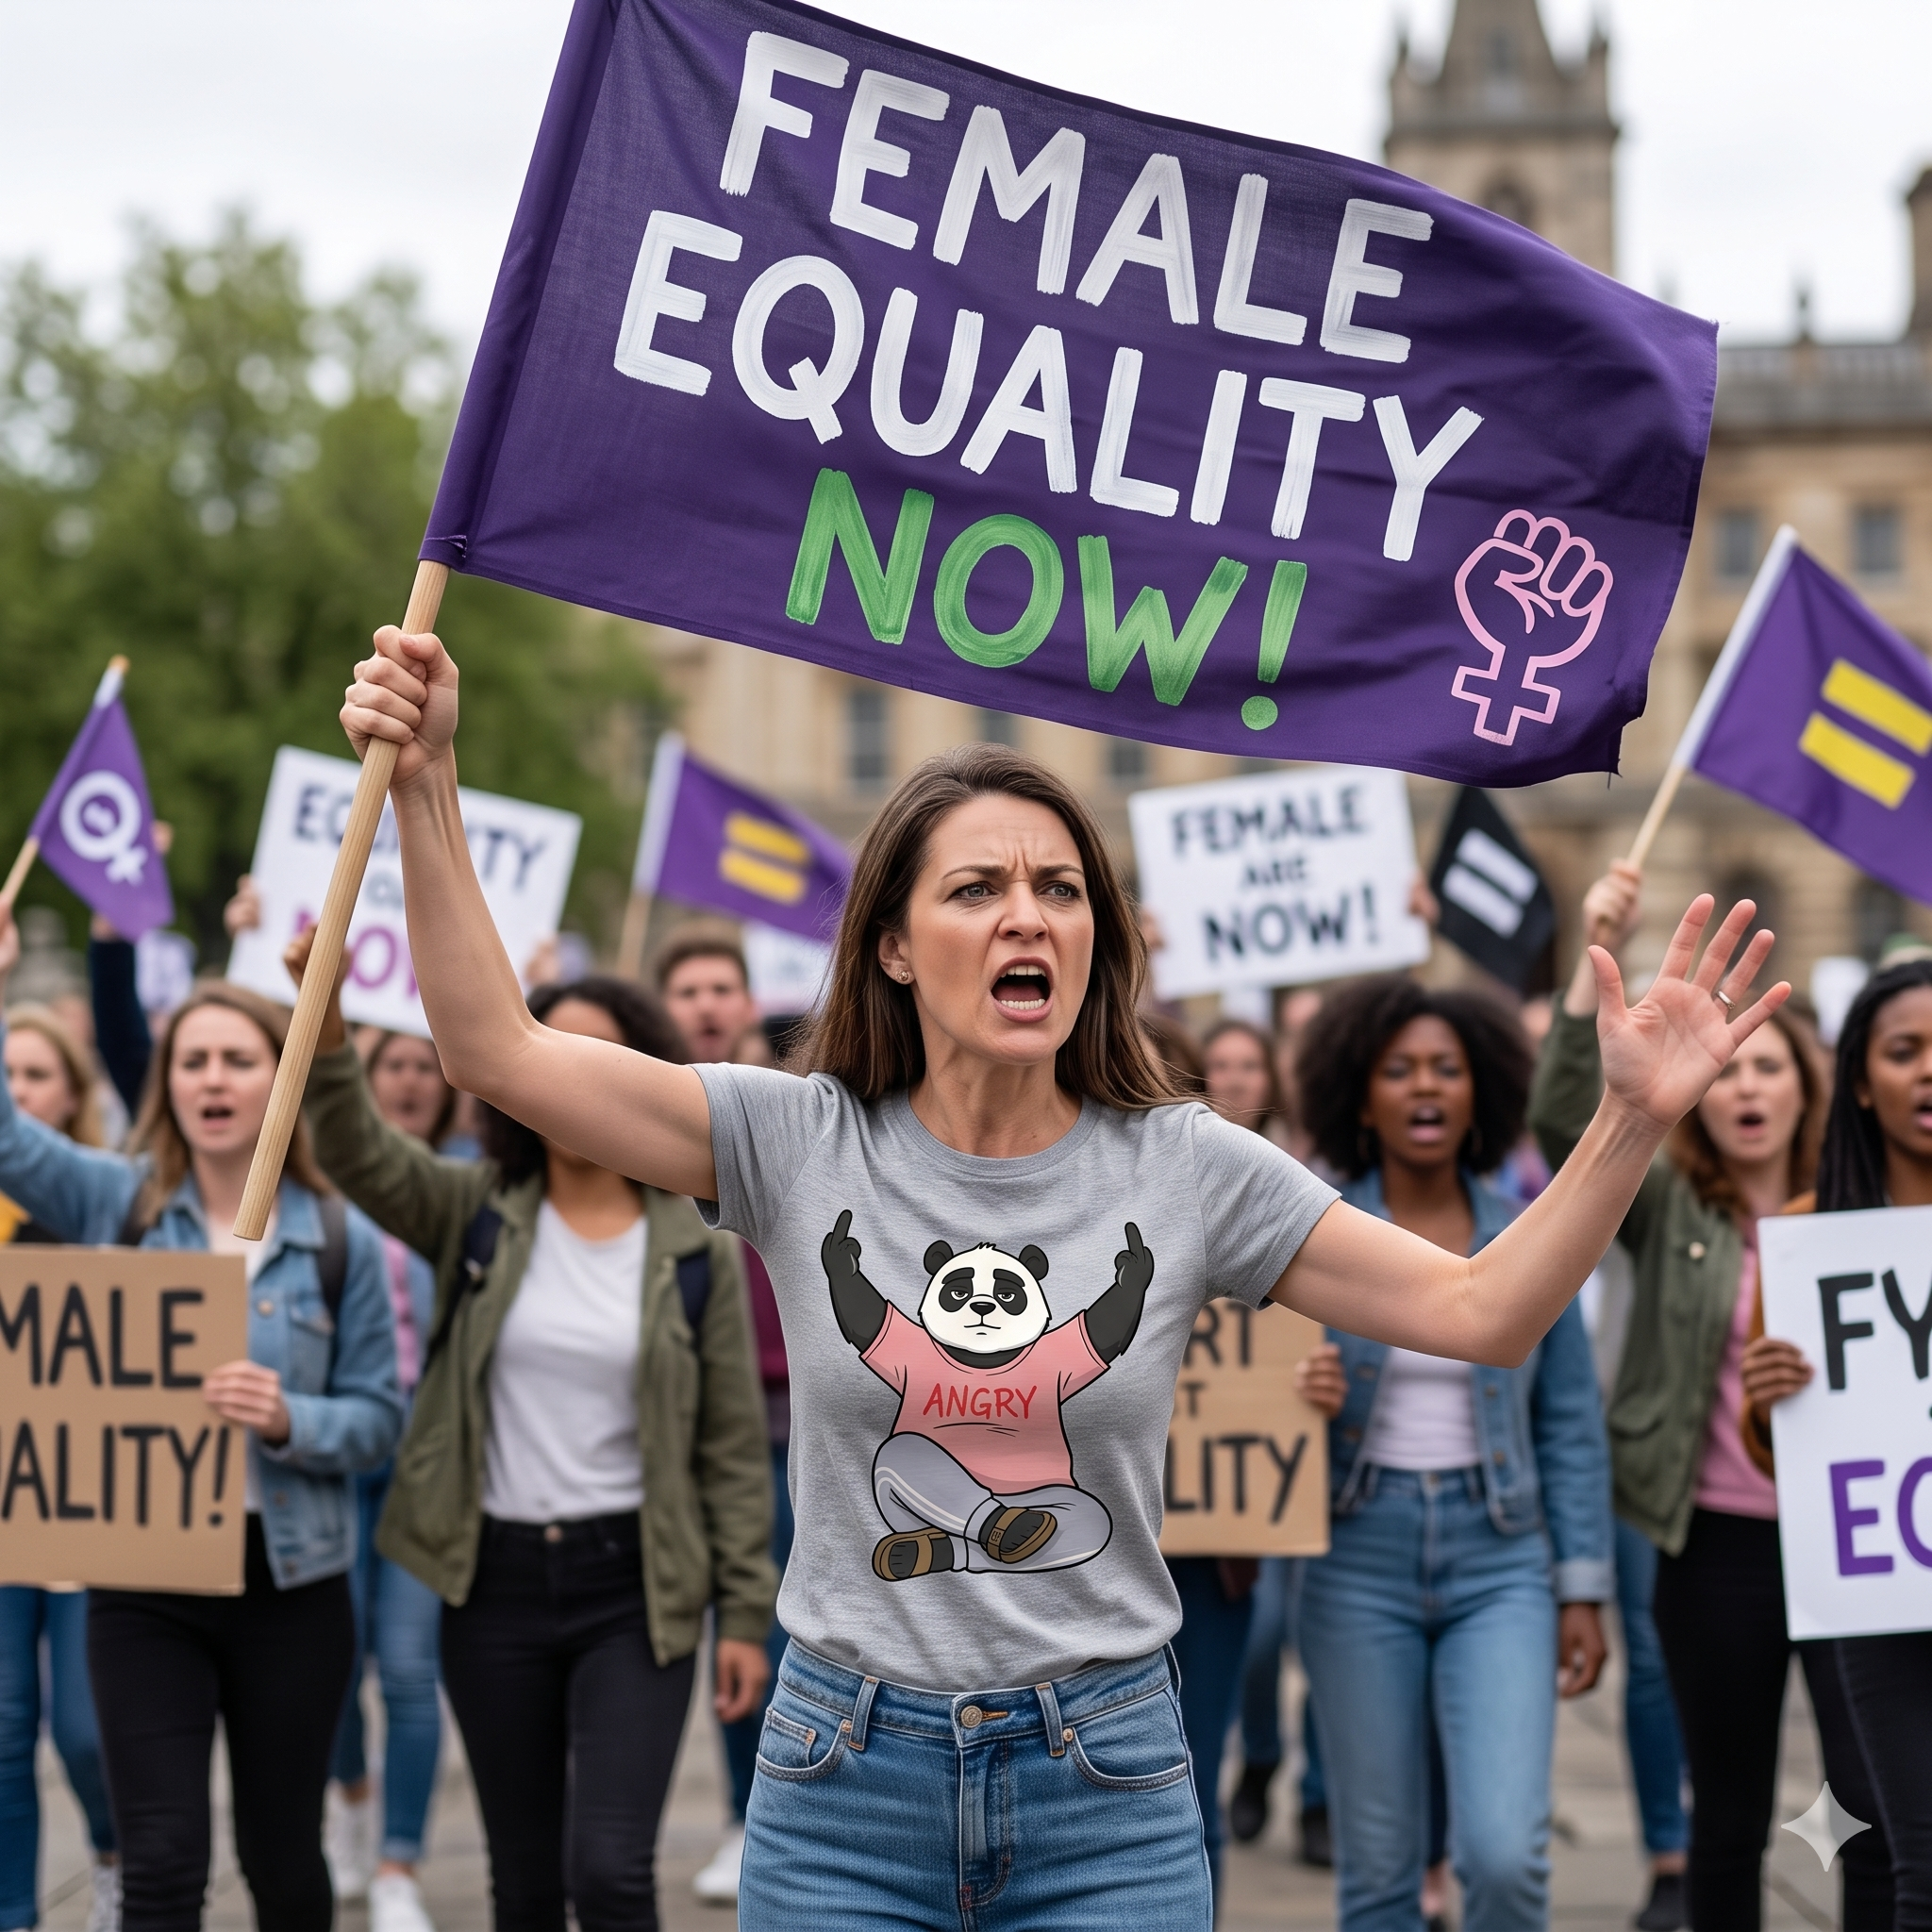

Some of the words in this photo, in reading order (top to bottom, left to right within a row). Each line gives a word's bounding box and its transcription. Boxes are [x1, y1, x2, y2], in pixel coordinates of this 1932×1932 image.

[719, 29, 1435, 364] FEMALE
[613, 209, 1485, 562] EQUALITY
[785, 467, 1308, 731] NOW!
[1171, 784, 1369, 856] FEMALE
[1203, 882, 1378, 962] NOW!
[923, 1382, 1038, 1420] ANGRY
